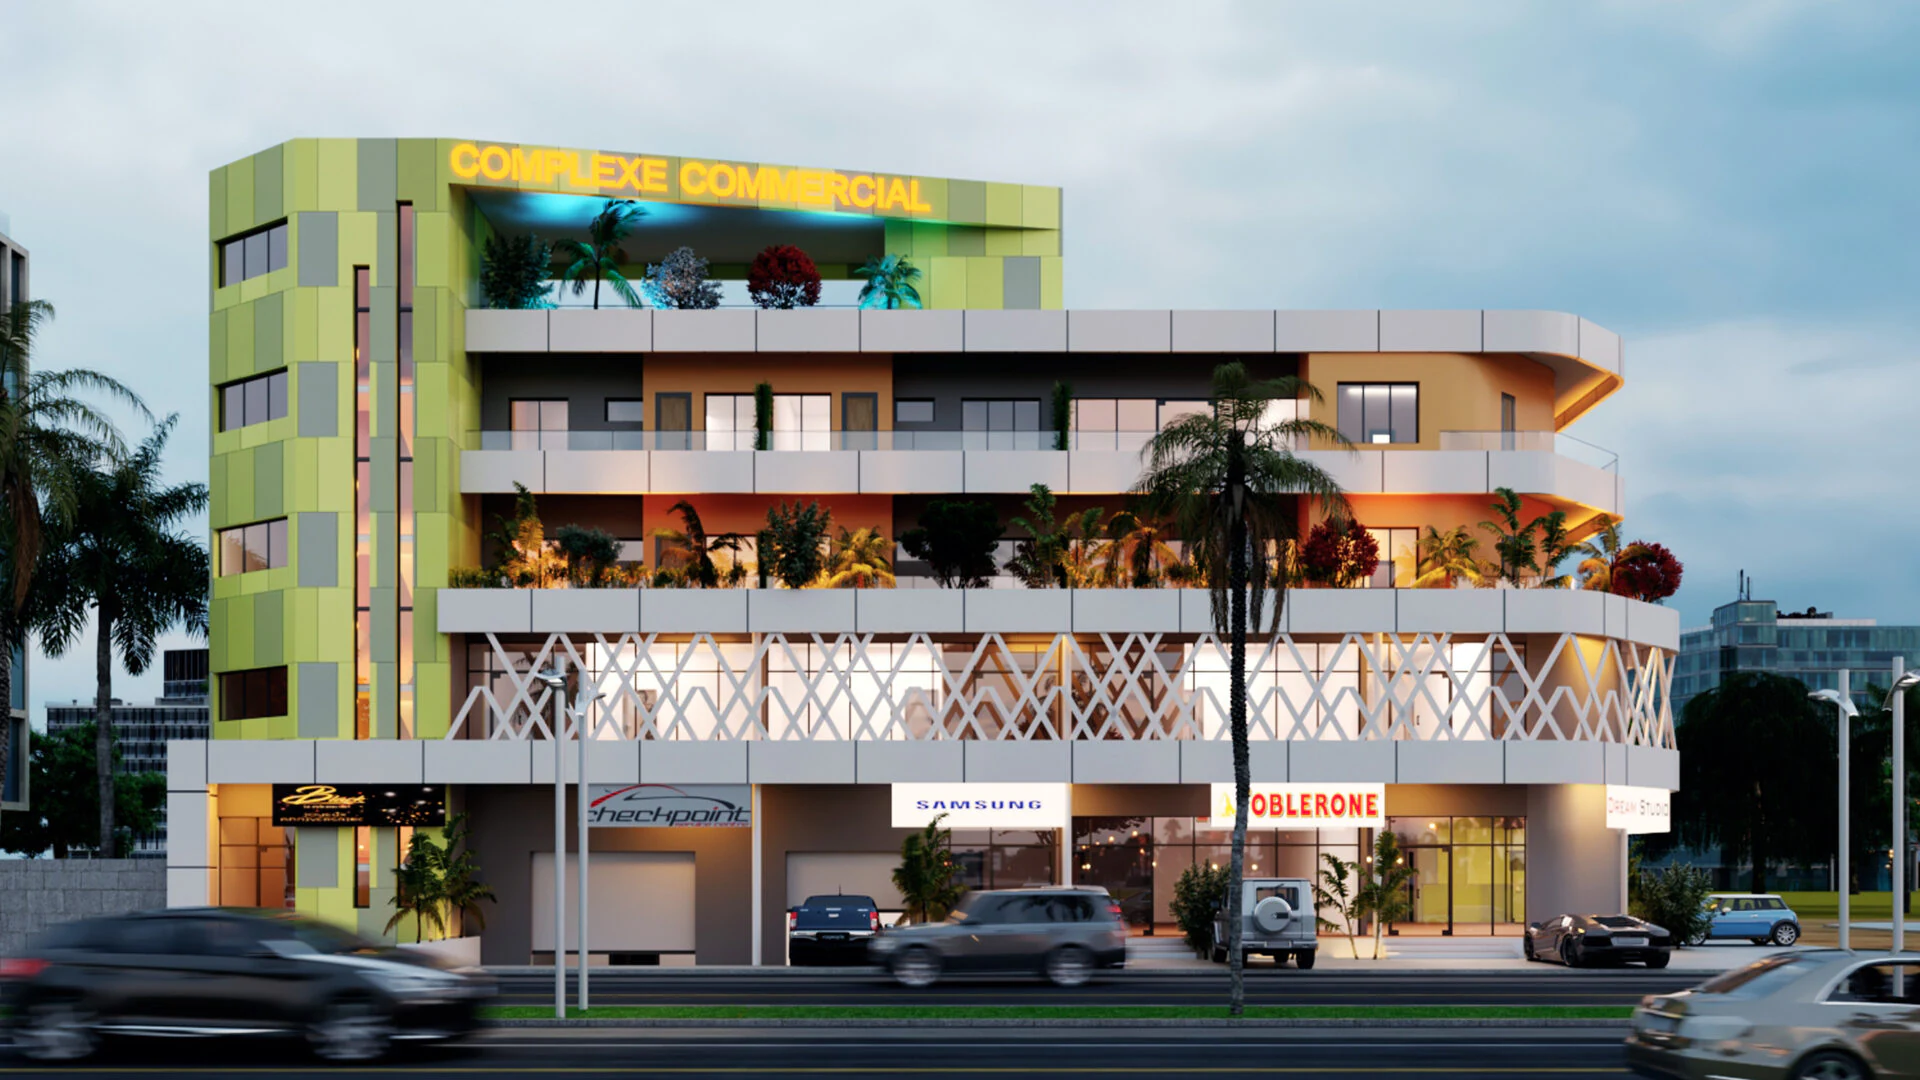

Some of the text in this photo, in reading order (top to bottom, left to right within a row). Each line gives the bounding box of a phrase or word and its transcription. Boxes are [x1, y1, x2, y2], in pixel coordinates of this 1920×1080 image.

[450, 143, 931, 212] COMPLEXE COMMERCIAL
[916, 800, 1042, 810] SAMSUNG
[1248, 792, 1379, 818] OBLERONE
